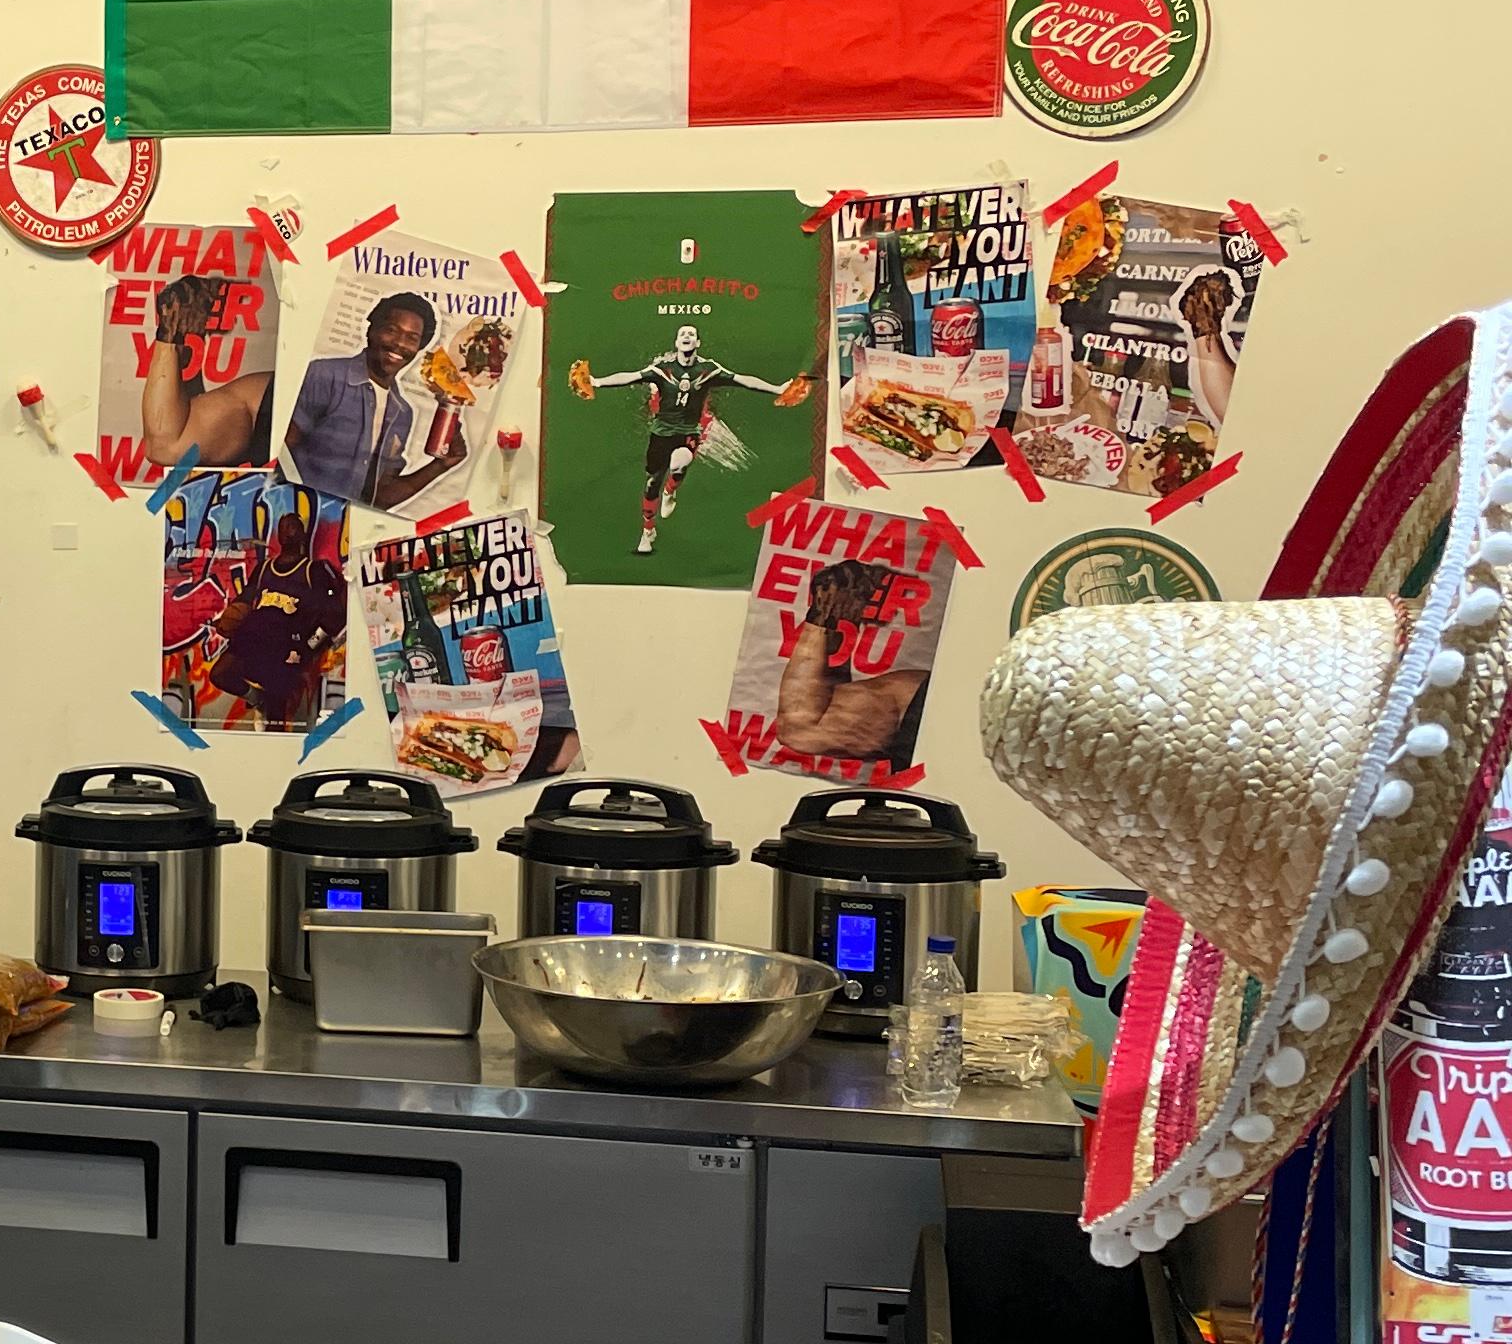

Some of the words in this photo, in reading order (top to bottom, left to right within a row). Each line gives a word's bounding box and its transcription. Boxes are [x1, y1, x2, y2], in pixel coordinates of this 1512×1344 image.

[1065, 2, 1119, 24] DRINK
[1013, 60, 1032, 90] YOUR
[1026, 86, 1058, 114] FAMILY
[1057, 108, 1080, 122] AND
[1082, 113, 1111, 123] YOUR
[1113, 94, 1158, 122] FRIENDS
[1034, 78, 1058, 101] KEEP
[1066, 99, 1083, 112] ON
[1083, 103, 1102, 113] ICE
[1103, 100, 1126, 112] FOR
[1041, 59, 1134, 99] REFRESHING
[1, 84, 47, 127] TEXAS
[57, 76, 105, 95] COMP
[14, 106, 105, 157] TEXACO
[47, 137, 86, 179] T
[6, 201, 100, 241] PETROLEUM
[106, 141, 150, 226] PRODUCTS
[272, 212, 292, 241] TACO
[841, 188, 1021, 239] WHATEVER
[112, 226, 267, 278] WHAT
[352, 245, 470, 281] Whatever
[955, 224, 1026, 265] YOU
[613, 277, 760, 302] CHICHARITO
[929, 263, 1028, 302] WANT
[1116, 262, 1190, 283] CARNE
[446, 291, 518, 318] want!
[658, 304, 712, 316] MEXICO
[1081, 332, 1188, 364] CILANTRO
[1090, 370, 1168, 403] EBOLLA
[363, 517, 528, 586] WHATEVER
[769, 503, 944, 574] WHAT
[467, 552, 536, 596] YOU
[452, 587, 543, 637] WANT
[1411, 1050, 1512, 1104] Trip
[1406, 1089, 1512, 1158] AA
[698, 1153, 741, 1169] 냉동실
[1419, 1162, 1482, 1189] ROOT
